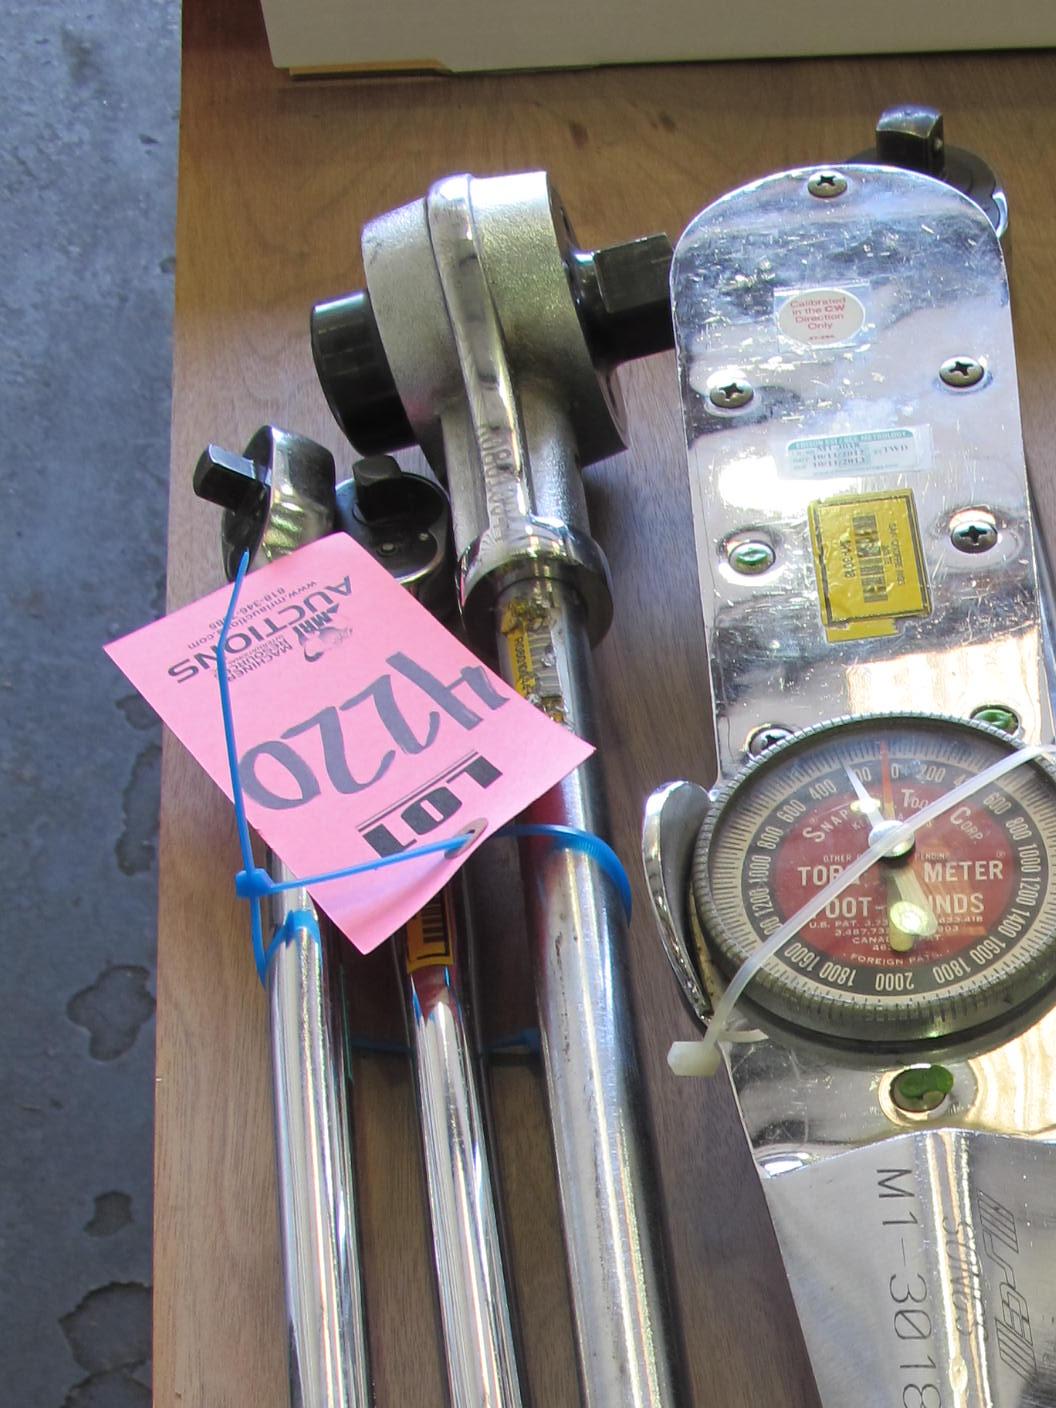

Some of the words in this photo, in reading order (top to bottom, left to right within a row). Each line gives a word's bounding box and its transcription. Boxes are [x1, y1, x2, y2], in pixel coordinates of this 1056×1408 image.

[795, 313, 844, 323] Direction
[824, 303, 845, 313] CW
[808, 322, 833, 331] Only
[209, 586, 286, 630] 818-346-785
[168, 575, 352, 684] AUCTIONS
[227, 641, 294, 682] MACHINER
[238, 650, 511, 811] 4220
[890, 762, 900, 779] 0
[808, 778, 838, 800] 400
[359, 754, 504, 859] LOT
[776, 799, 807, 823] 600
[983, 791, 1013, 815] 600
[756, 825, 784, 850] 800
[1005, 816, 1033, 842] 800
[748, 854, 772, 884] 1000
[823, 854, 852, 863] OTHER
[923, 859, 1004, 883] METER
[1017, 843, 1042, 873] 1000
[748, 888, 775, 918] 1200
[1015, 876, 1042, 907] 1200
[997, 907, 1032, 939] 1400
[783, 942, 821, 972] 1600
[850, 953, 904, 966] FOREIGN
[969, 935, 1008, 966] 1600
[818, 961, 857, 987] 1800
[874, 971, 916, 992] 2000
[932, 957, 972, 985] 1800
